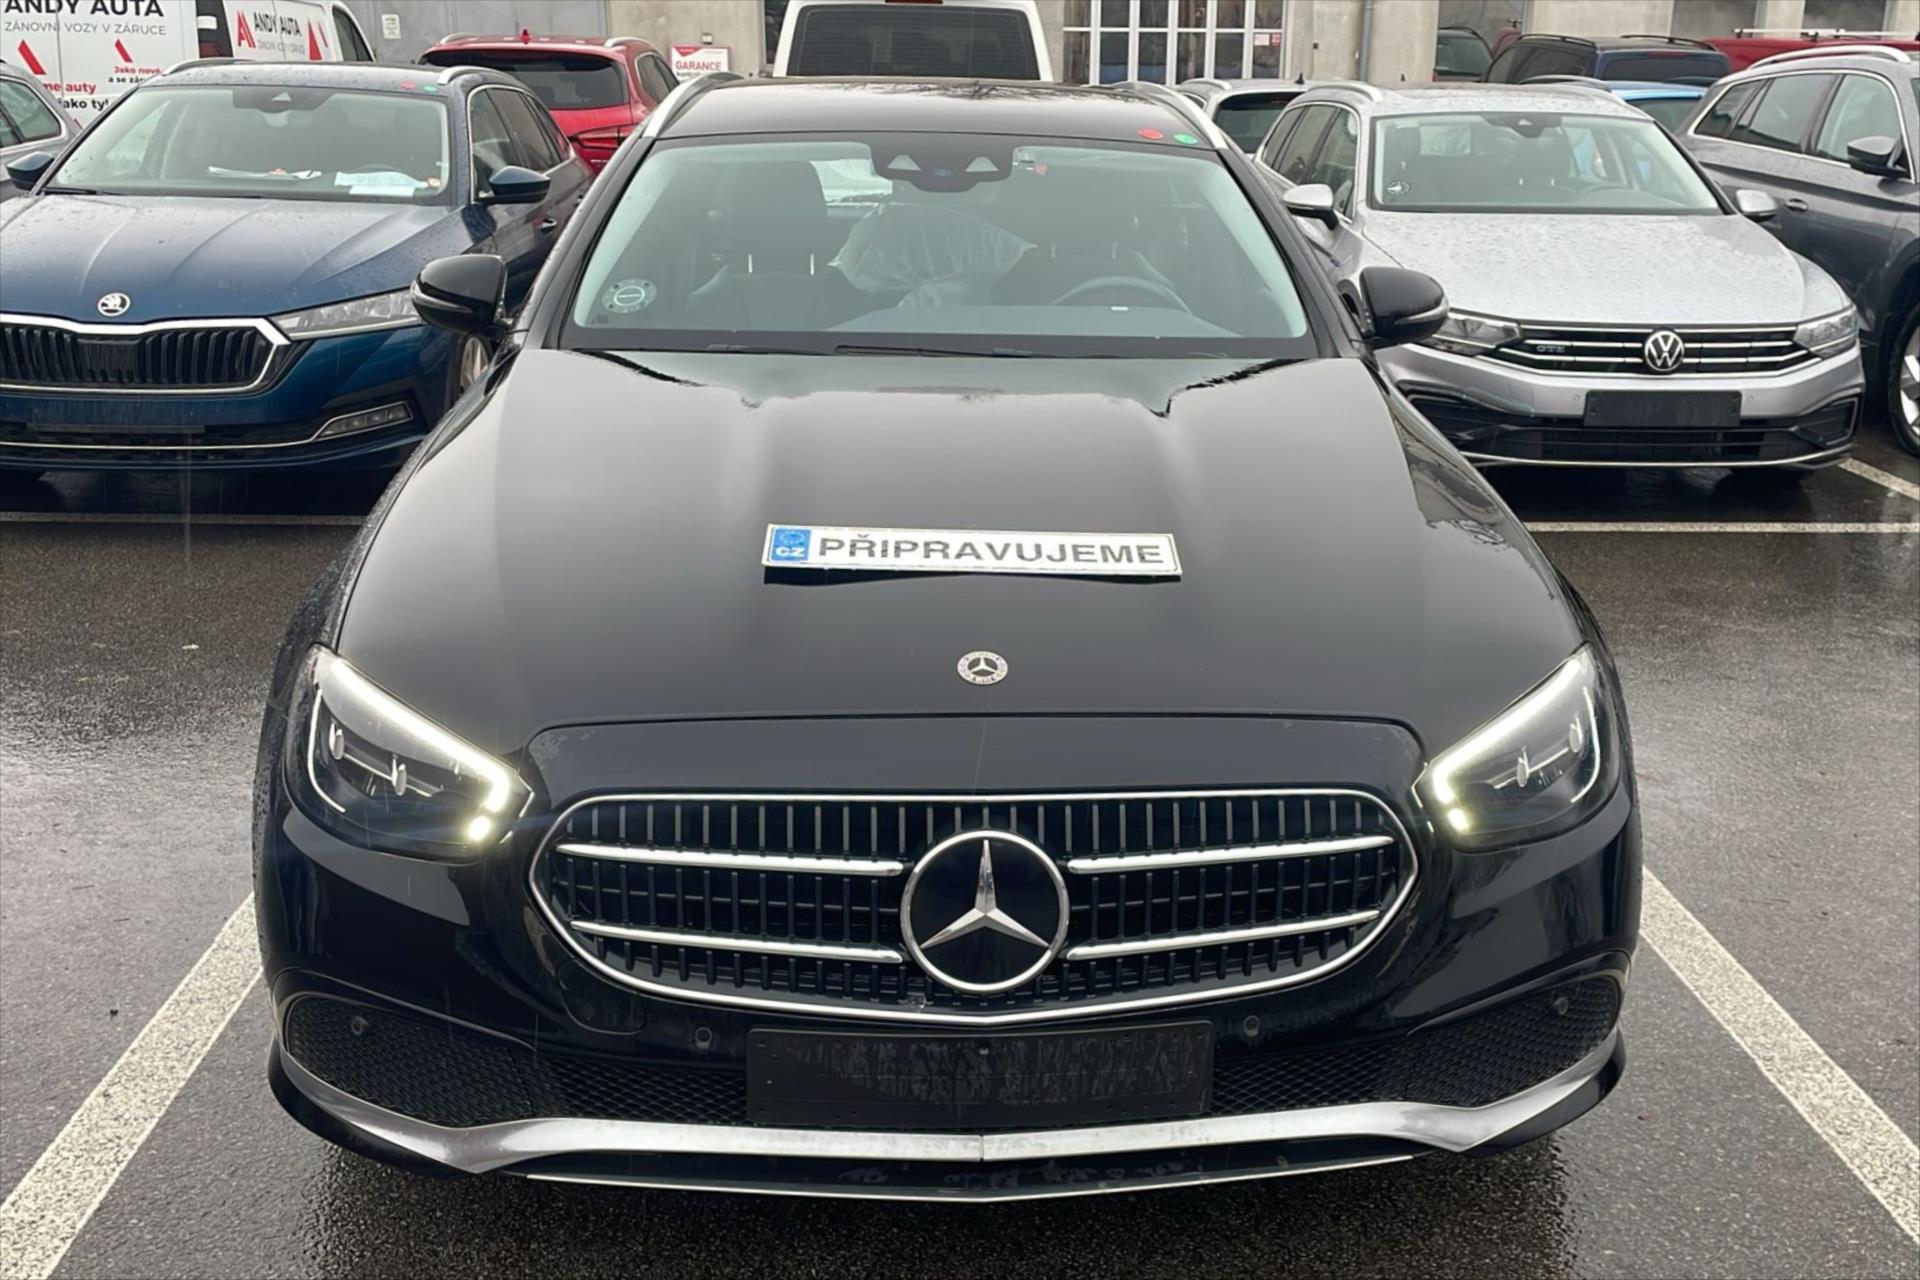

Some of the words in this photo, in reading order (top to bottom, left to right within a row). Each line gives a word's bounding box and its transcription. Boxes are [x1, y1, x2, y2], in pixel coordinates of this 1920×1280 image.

[5, 0, 79, 14] ANDY
[90, 0, 164, 17] AUTA
[5, 20, 60, 32] ZÁNOVN
[65, 22, 98, 33] VOZY
[102, 23, 111, 33] V
[114, 22, 166, 35] ZÁRUCE
[253, 11, 277, 33] ANDY
[280, 16, 302, 37] AUTA
[114, 66, 137, 74] Jako
[675, 60, 722, 71] GARANCE
[65, 83, 96, 94] auty
[775, 546, 805, 557] CZ
[819, 533, 1164, 564] PŘIPRAVUJEME
